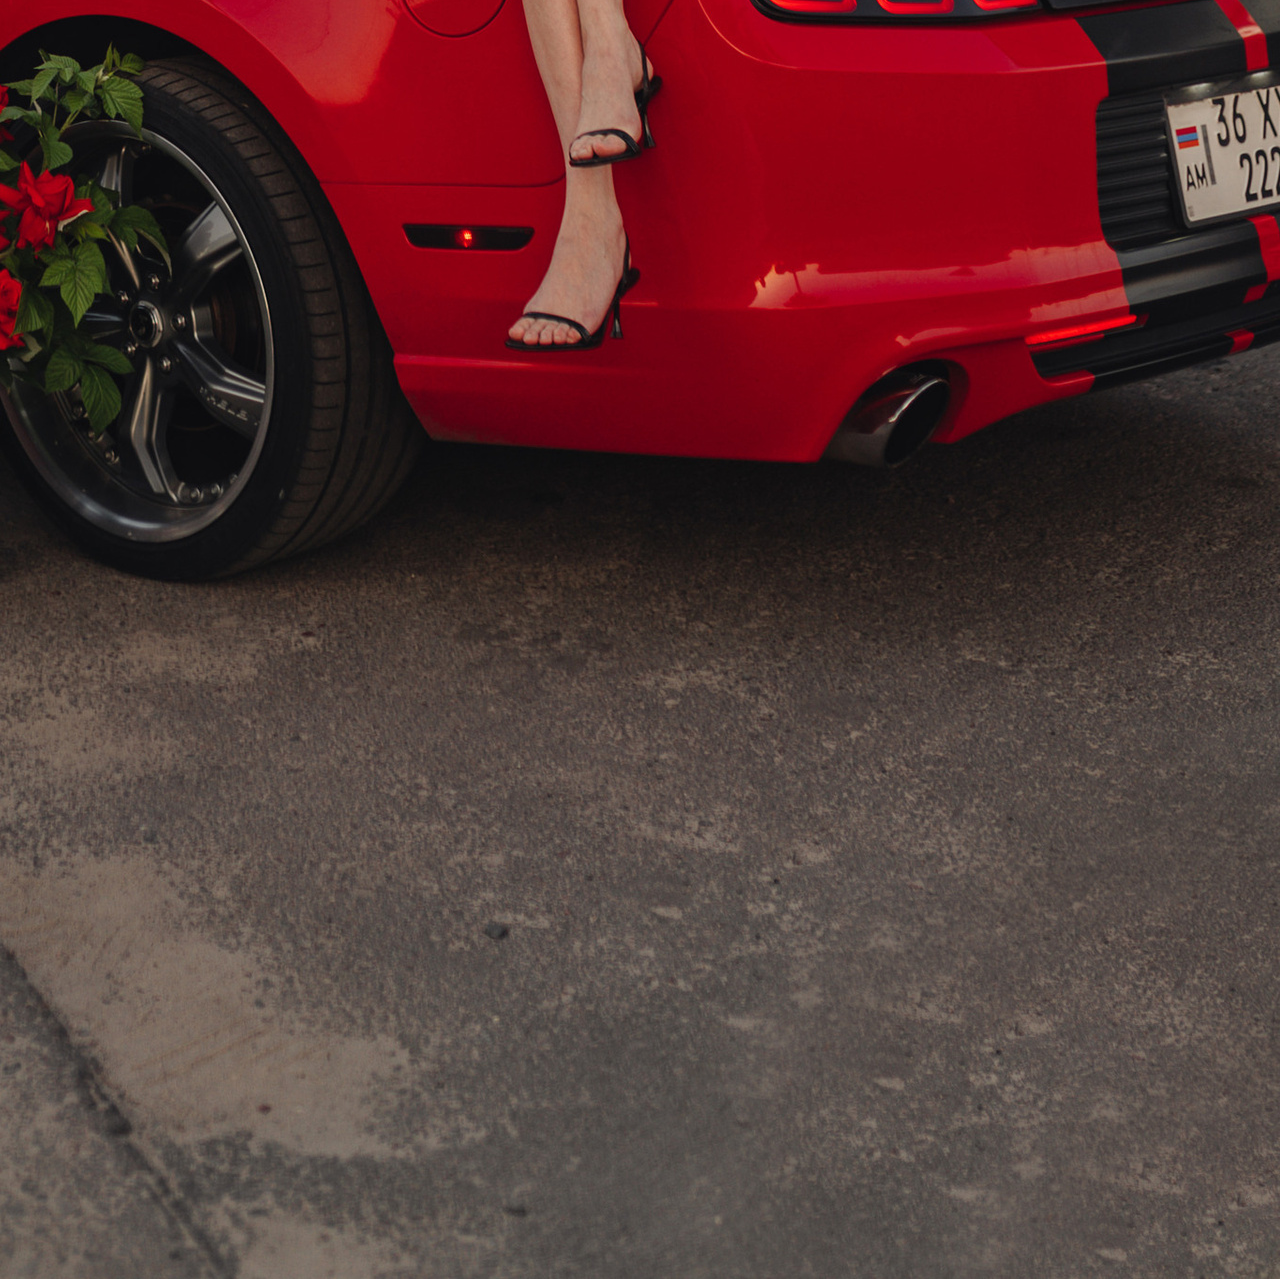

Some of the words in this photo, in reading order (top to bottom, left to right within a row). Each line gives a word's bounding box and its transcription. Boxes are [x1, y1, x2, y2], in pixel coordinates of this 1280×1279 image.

[1212, 94, 1247, 147] 36
[1256, 87, 1280, 140] X
[1186, 162, 1209, 191] AM
